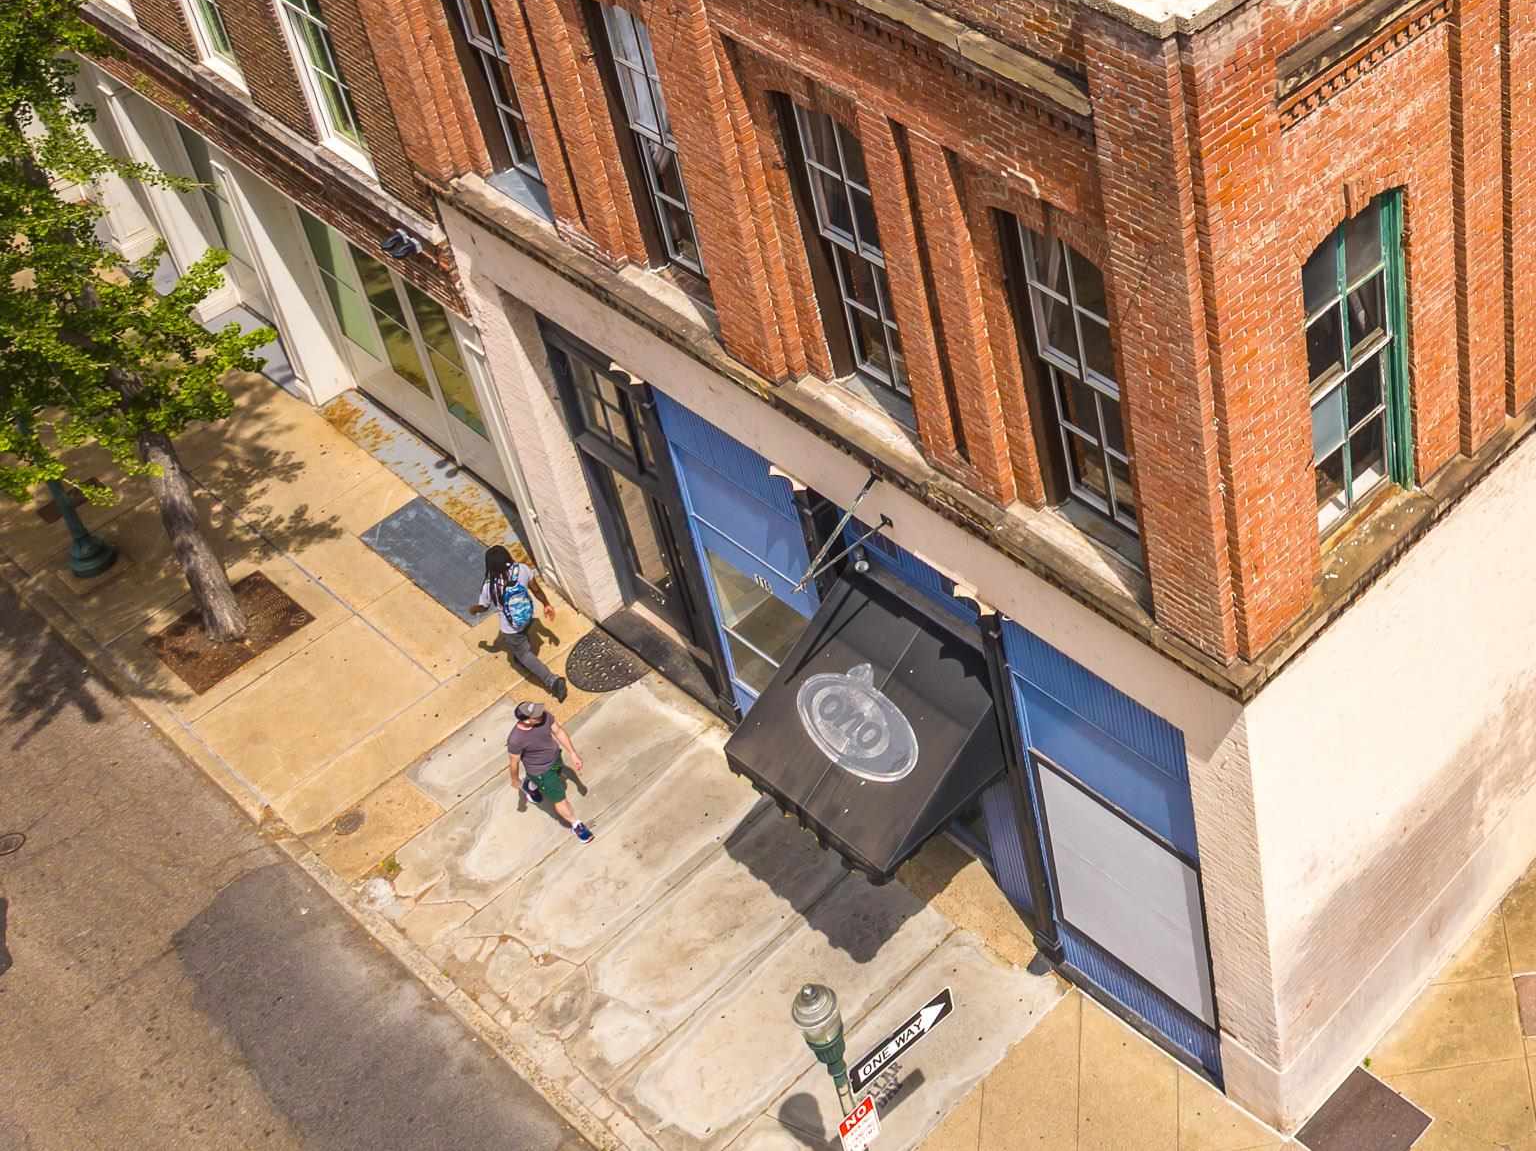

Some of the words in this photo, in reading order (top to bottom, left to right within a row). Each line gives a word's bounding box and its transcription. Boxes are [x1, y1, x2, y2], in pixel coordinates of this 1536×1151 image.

[863, 1047, 892, 1076] ONE
[895, 1018, 923, 1047] WAY
[845, 1105, 867, 1130] NO
